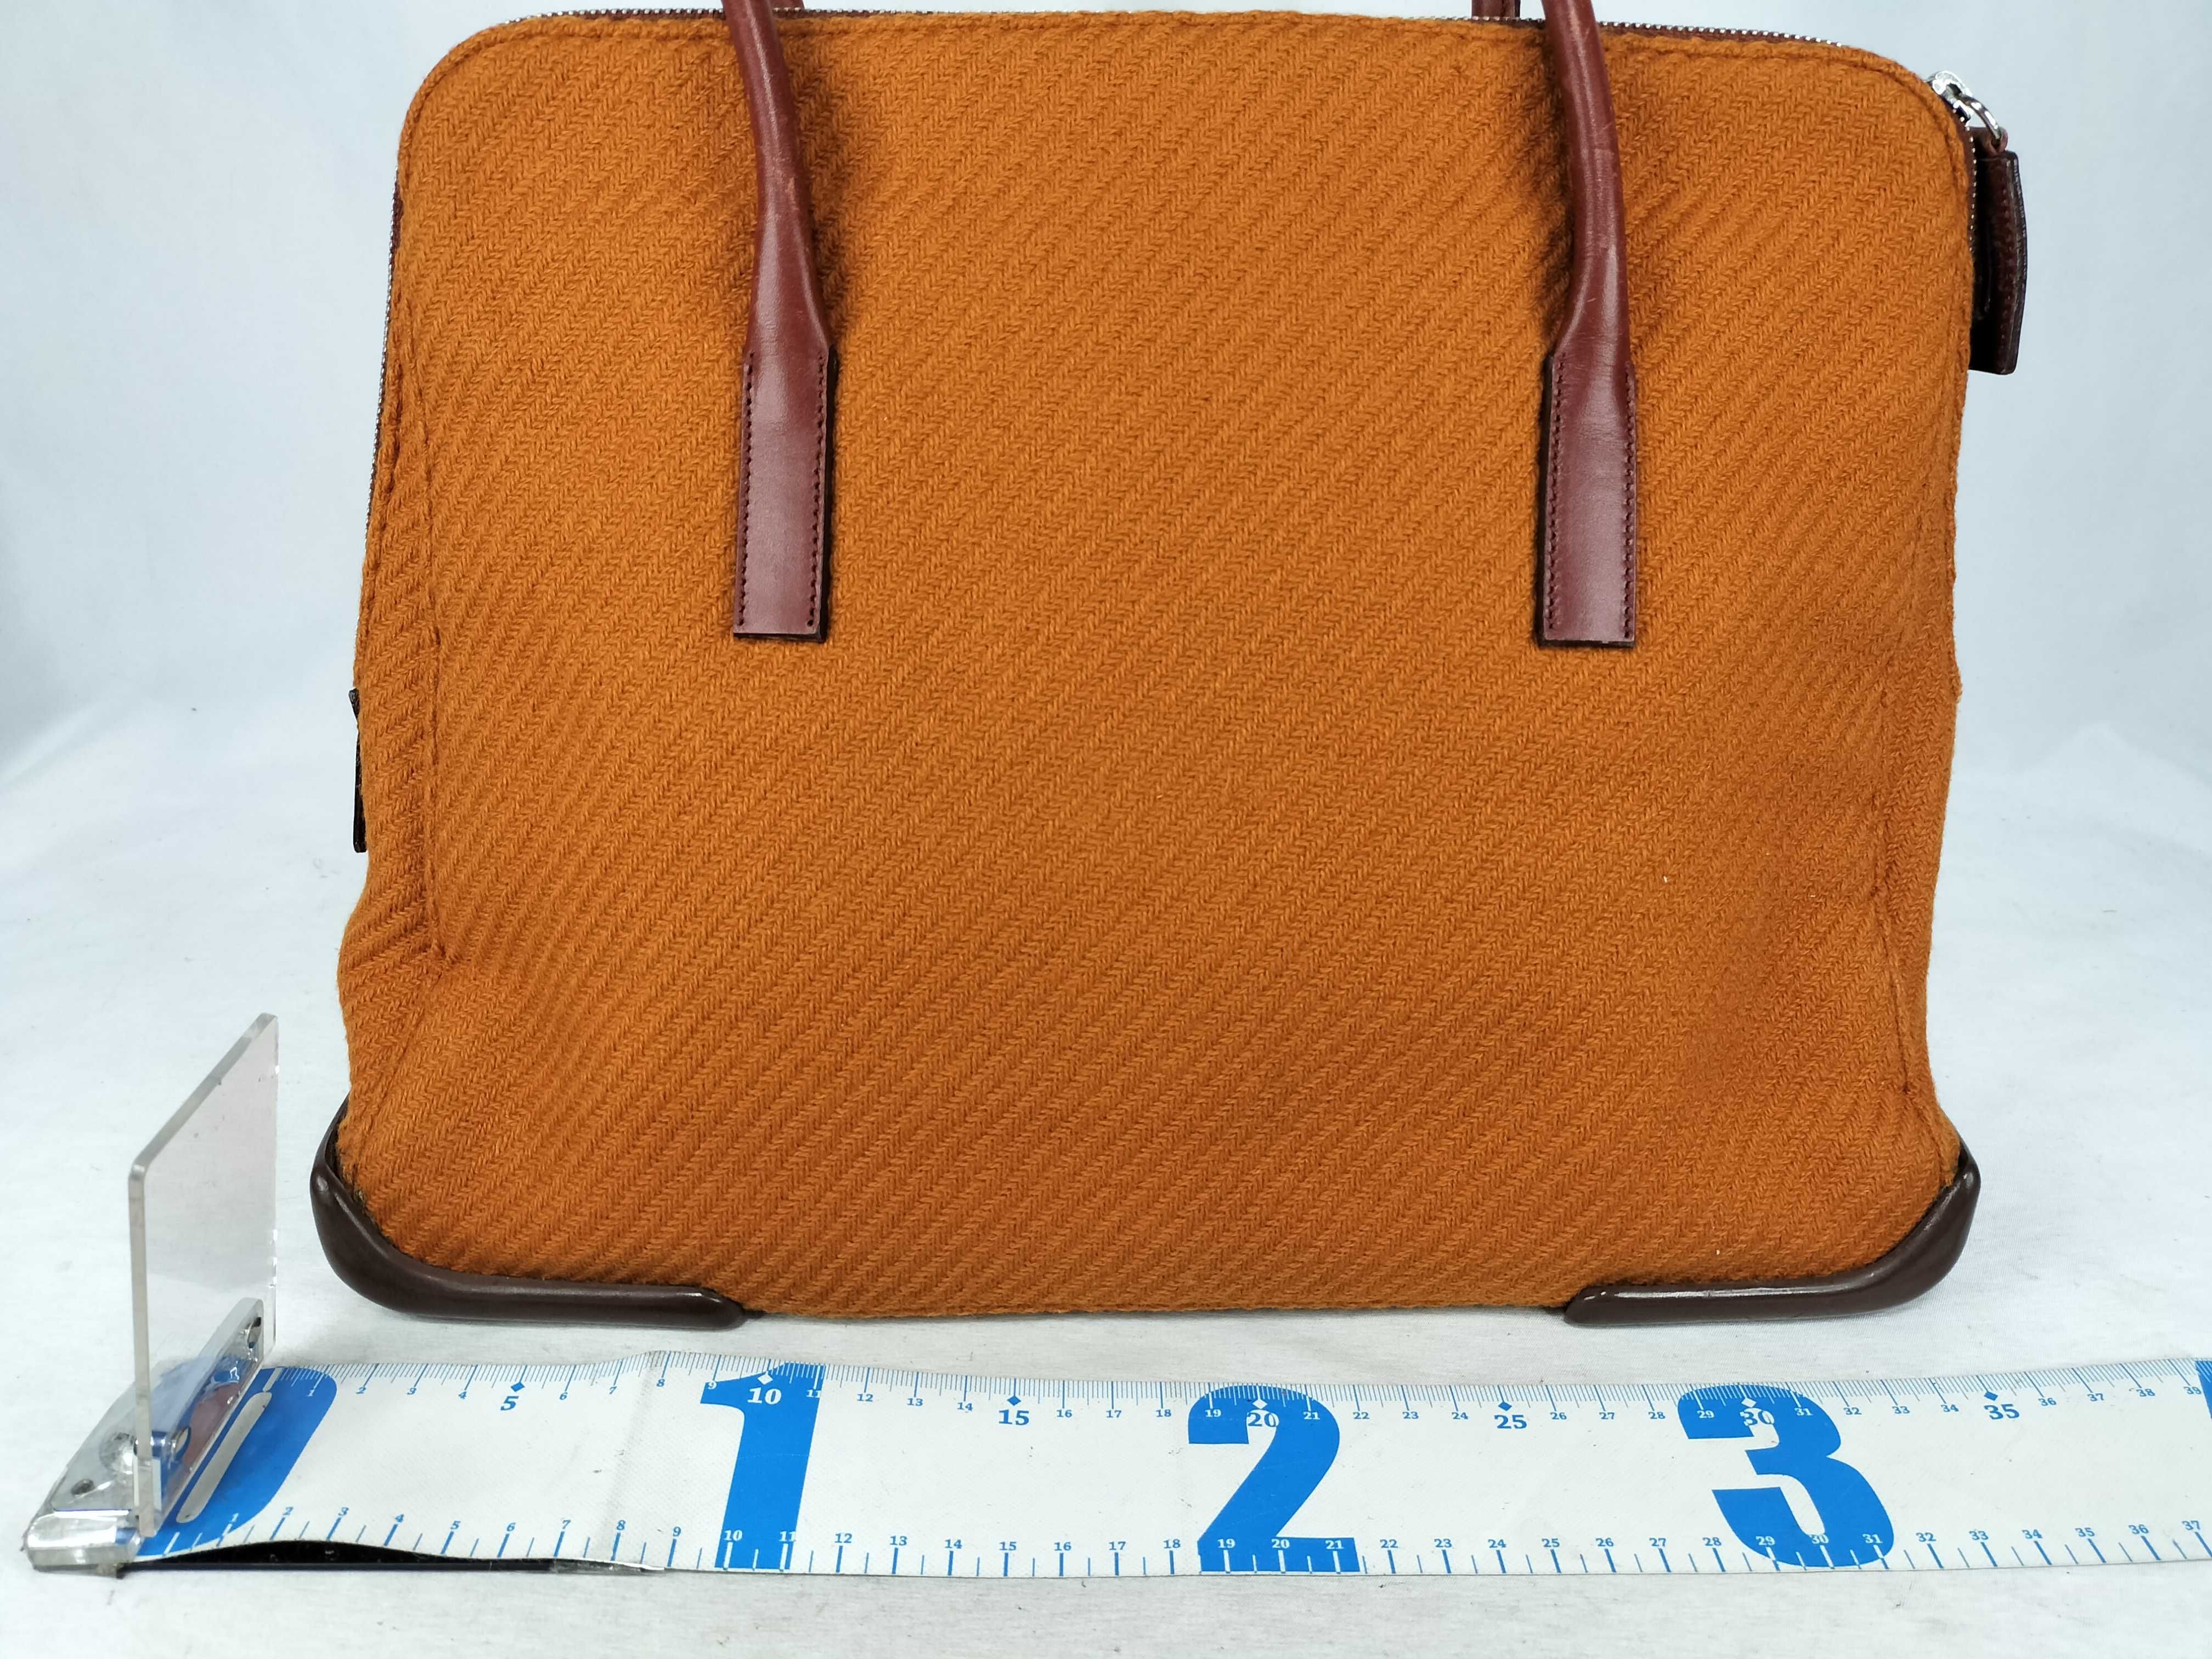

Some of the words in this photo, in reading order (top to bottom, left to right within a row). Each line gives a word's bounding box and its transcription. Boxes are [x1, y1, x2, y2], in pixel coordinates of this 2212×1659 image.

[407, 1387, 416, 1395] 3
[458, 1391, 467, 1400] 4
[500, 1396, 520, 1411] 5
[609, 1386, 617, 1395] 7
[657, 1379, 664, 1387] 8
[747, 1389, 782, 1404] 10
[806, 1390, 821, 1398] 11
[856, 1393, 873, 1402] 12
[907, 1398, 923, 1407] 13
[957, 1402, 973, 1410] 14
[998, 1410, 1030, 1426] 15
[1056, 1409, 1072, 1418] 16
[1156, 1409, 1172, 1417] 18
[1205, 1409, 1221, 1417] 19
[1247, 1410, 1279, 1427] 20
[1304, 1411, 1319, 1420] 21
[1353, 1412, 1369, 1420] 22
[1403, 1412, 1419, 1420] 23
[1452, 1412, 1468, 1420] 24
[1494, 1414, 1527, 1429] 25
[1550, 1412, 1566, 1420] 26
[1599, 1412, 1615, 1420] 27
[1649, 1412, 1665, 1420] 28
[1697, 1410, 1714, 1419] 29
[1740, 1408, 1774, 1425] 30
[1795, 1408, 1813, 1416] 31
[1843, 1407, 1861, 1415] 32
[1893, 1406, 1910, 1414] 33
[1942, 1404, 1959, 1413] 34
[1984, 1404, 2019, 1420] 35
[2039, 1398, 2056, 1406] 36
[2087, 1393, 2104, 1401] 37
[2136, 1389, 2154, 1397] 38
[2183, 1386, 2202, 1395] 39
[700, 1363, 826, 1569] 1
[1188, 1385, 1360, 1572] 2
[1678, 1384, 1894, 1567] 3
[232, 1513, 239, 1522] 1
[338, 1508, 348, 1516] 3
[395, 1514, 404, 1523] 4
[451, 1521, 460, 1530] 5
[506, 1523, 515, 1531] 6
[562, 1520, 570, 1529] 7
[617, 1520, 625, 1530] 8
[673, 1527, 681, 1537] 9
[725, 1530, 742, 1541] 10
[780, 1531, 795, 1542] 11
[835, 1533, 853, 1543] 12
[890, 1536, 907, 1546] 13
[945, 1539, 962, 1549] 14
[1000, 1541, 1017, 1551] 15
[1054, 1541, 1071, 1551] 16
[1109, 1541, 1125, 1551] 17
[1164, 1539, 1180, 1549] 18
[1218, 1538, 1235, 1548] 19
[1272, 1538, 1289, 1548] 20
[1327, 1540, 1343, 1549] 21
[1380, 1539, 1398, 1548] 22
[1434, 1539, 1452, 1548] 23
[1488, 1539, 1506, 1548] 24
[1542, 1538, 1560, 1548] 25
[1596, 1538, 1614, 1547] 26
[1650, 1538, 1667, 1547] 27
[1703, 1537, 1722, 1547] 28
[1757, 1536, 1775, 1545] 29
[1809, 1535, 1829, 1544] 30
[1863, 1534, 1882, 1543] 31
[1916, 1532, 1936, 1542] 32
[1970, 1531, 1989, 1540] 33
[2023, 1529, 2042, 1539] 34
[2075, 1528, 2095, 1537] 35
[2129, 1525, 2149, 1535] 36
[2182, 1521, 2201, 1531] 37
